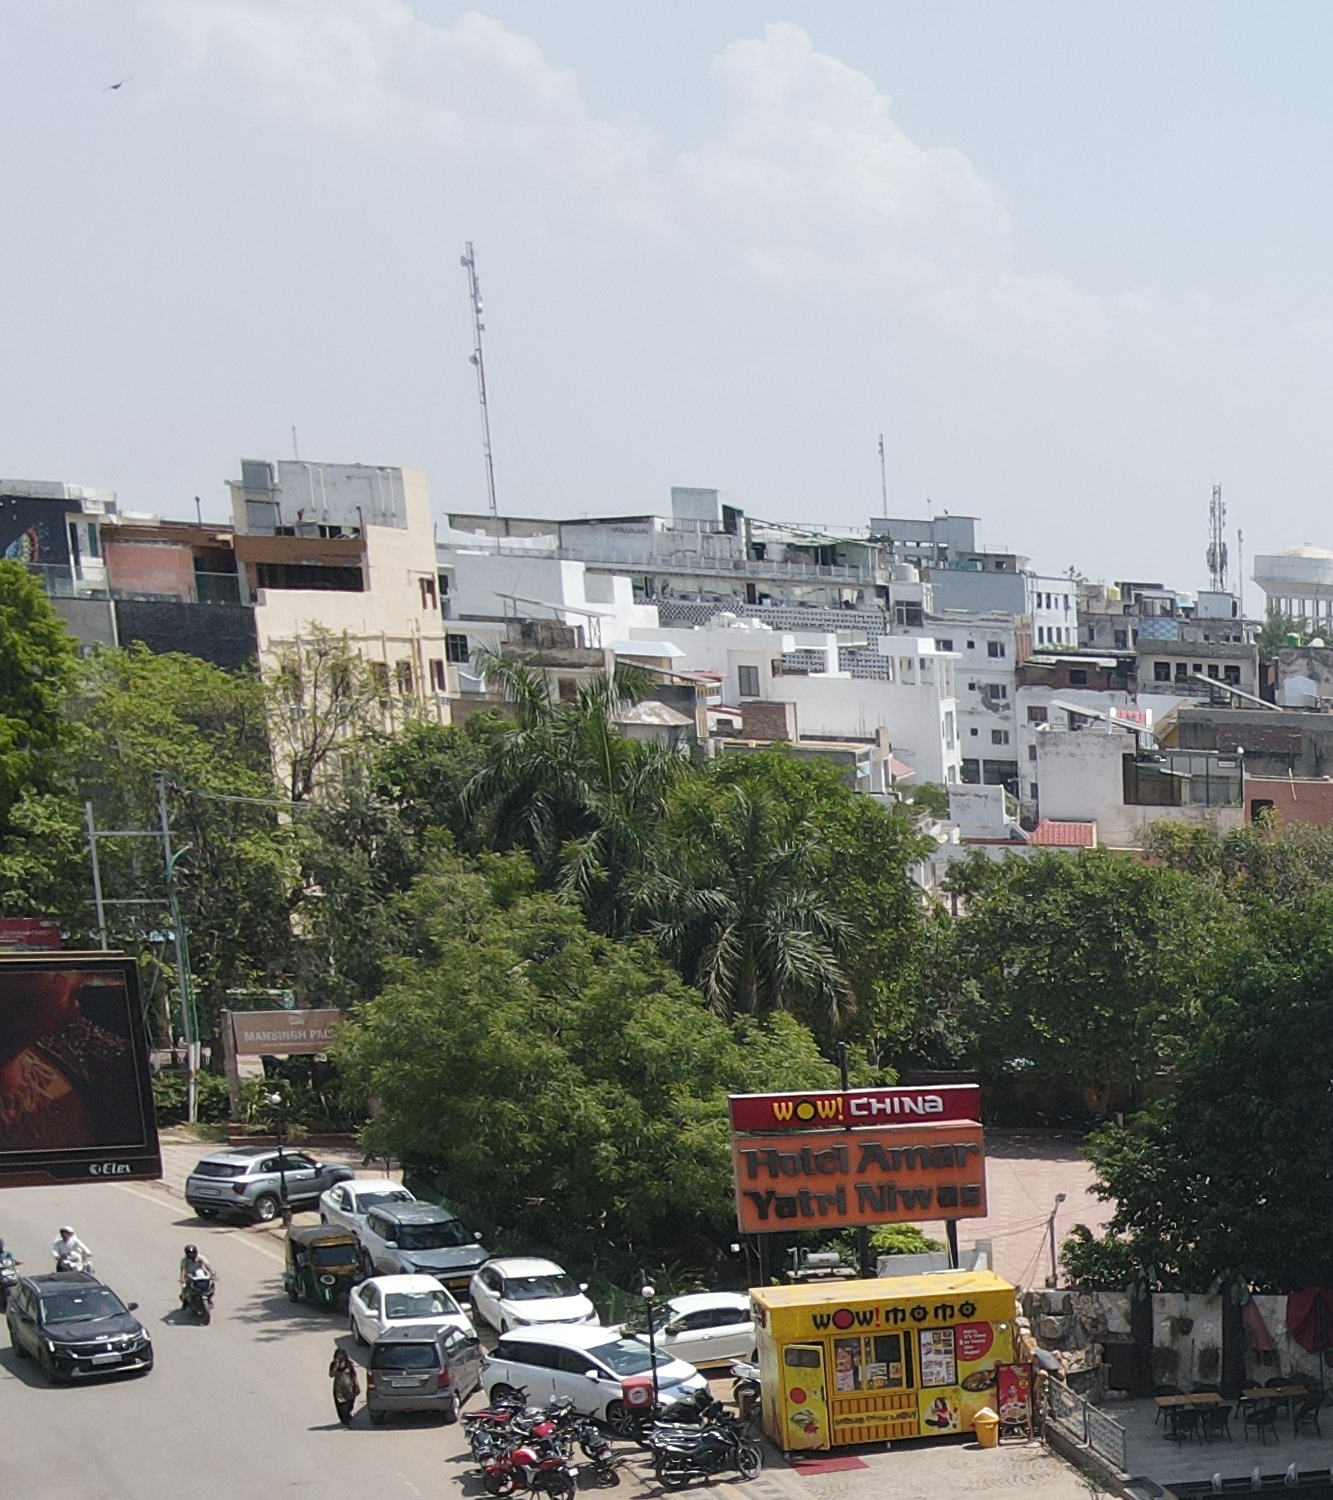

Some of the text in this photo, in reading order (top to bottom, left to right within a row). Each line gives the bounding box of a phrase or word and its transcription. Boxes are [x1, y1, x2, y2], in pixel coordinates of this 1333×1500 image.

[773, 1097, 844, 1121] WOW!
[740, 1142, 980, 1179] Hotel Amar
[743, 1181, 981, 1220] Yatri Niwas
[812, 1306, 881, 1329] WOW!
